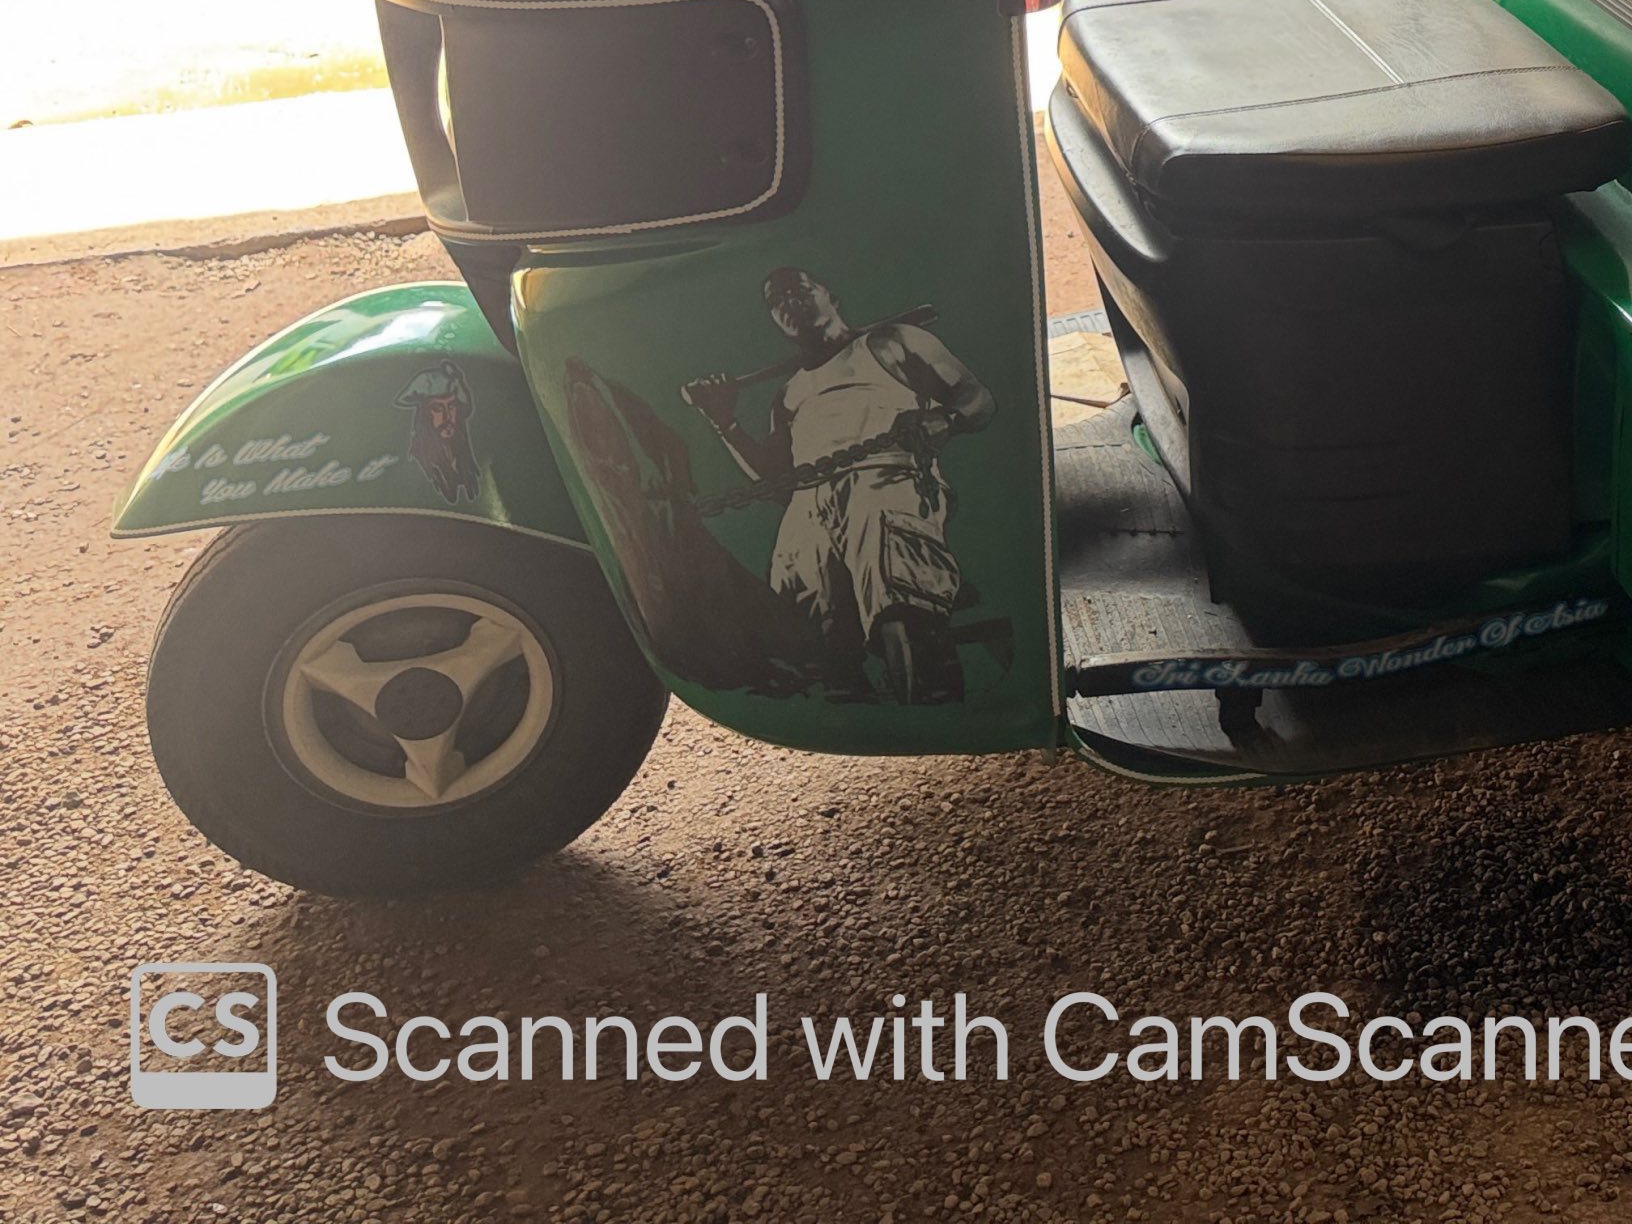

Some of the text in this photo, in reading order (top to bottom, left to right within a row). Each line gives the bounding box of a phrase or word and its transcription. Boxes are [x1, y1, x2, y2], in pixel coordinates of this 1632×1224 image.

[194, 443, 227, 470] Is
[233, 432, 330, 466] What
[200, 455, 399, 505] You Make it
[1133, 599, 1609, 687] Sri Lanka Wonder Of Asia
